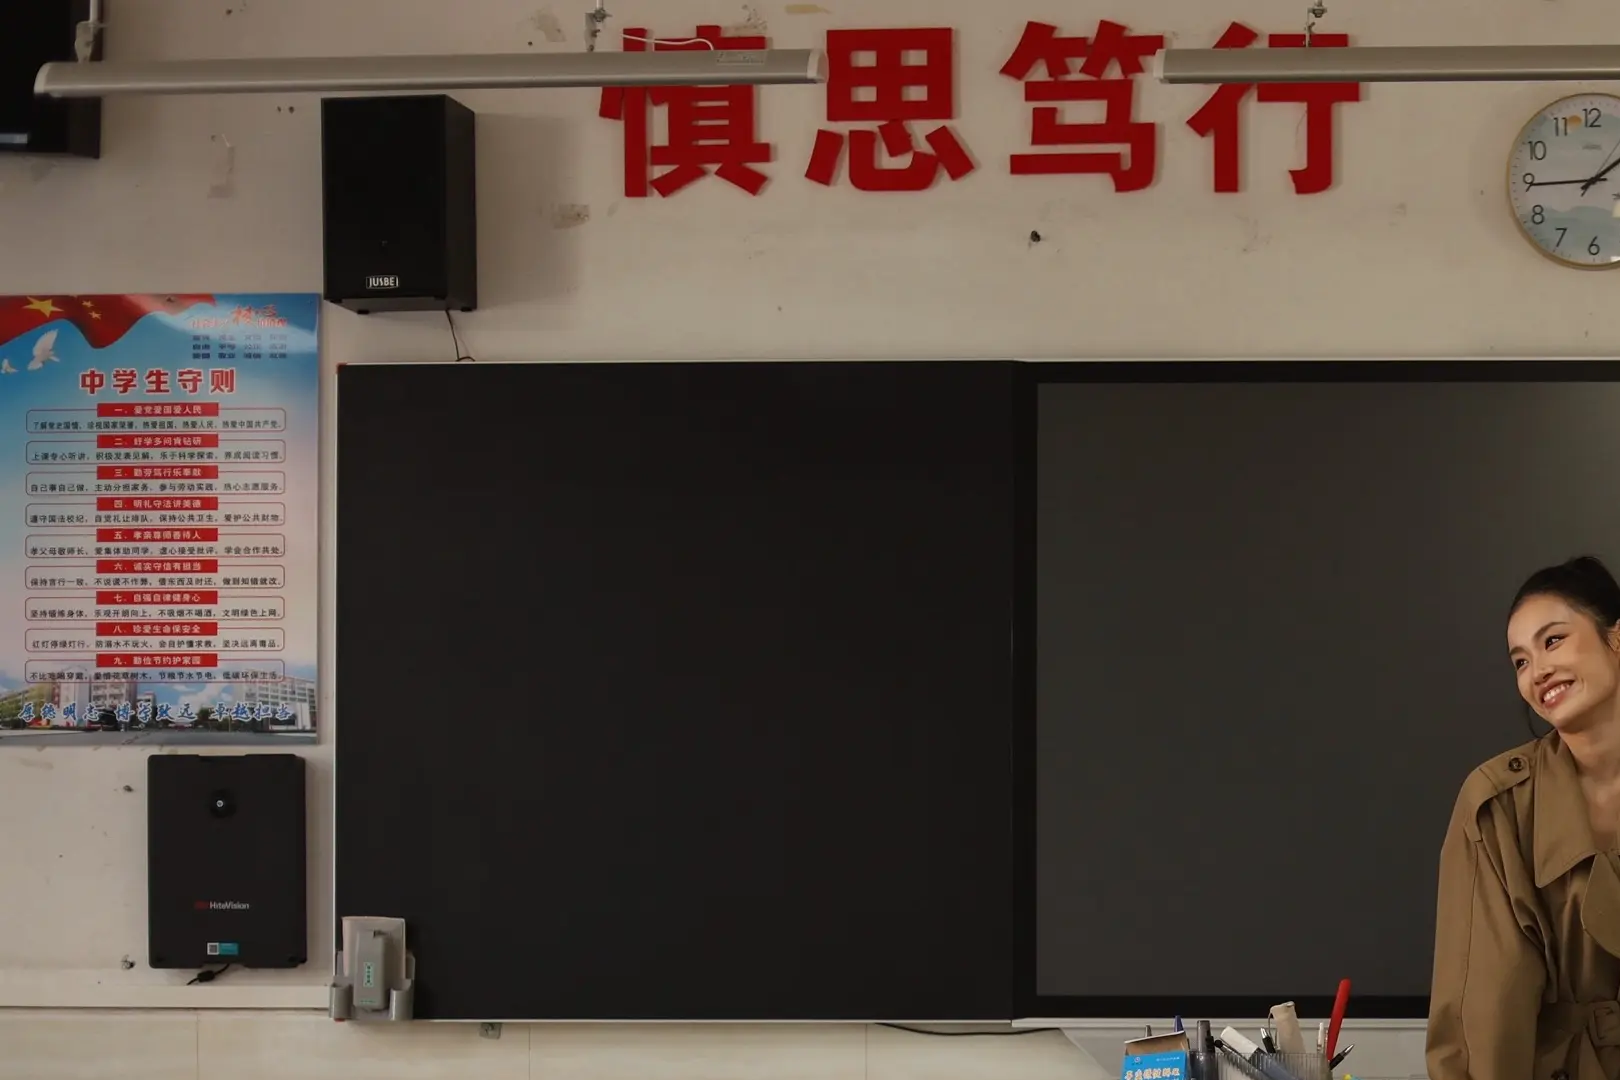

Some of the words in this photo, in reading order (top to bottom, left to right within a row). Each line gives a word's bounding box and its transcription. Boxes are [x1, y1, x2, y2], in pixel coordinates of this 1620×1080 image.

[599, 19, 1362, 199] 慎思笃行
[1582, 108, 1601, 128] 12
[1554, 117, 1568, 136] 11
[1528, 141, 1547, 160] 10
[1523, 173, 1535, 192] 9
[1531, 205, 1545, 225] 8
[1555, 228, 1567, 247] 7
[1588, 236, 1600, 255] 6
[81, 369, 236, 394] 中学生守则
